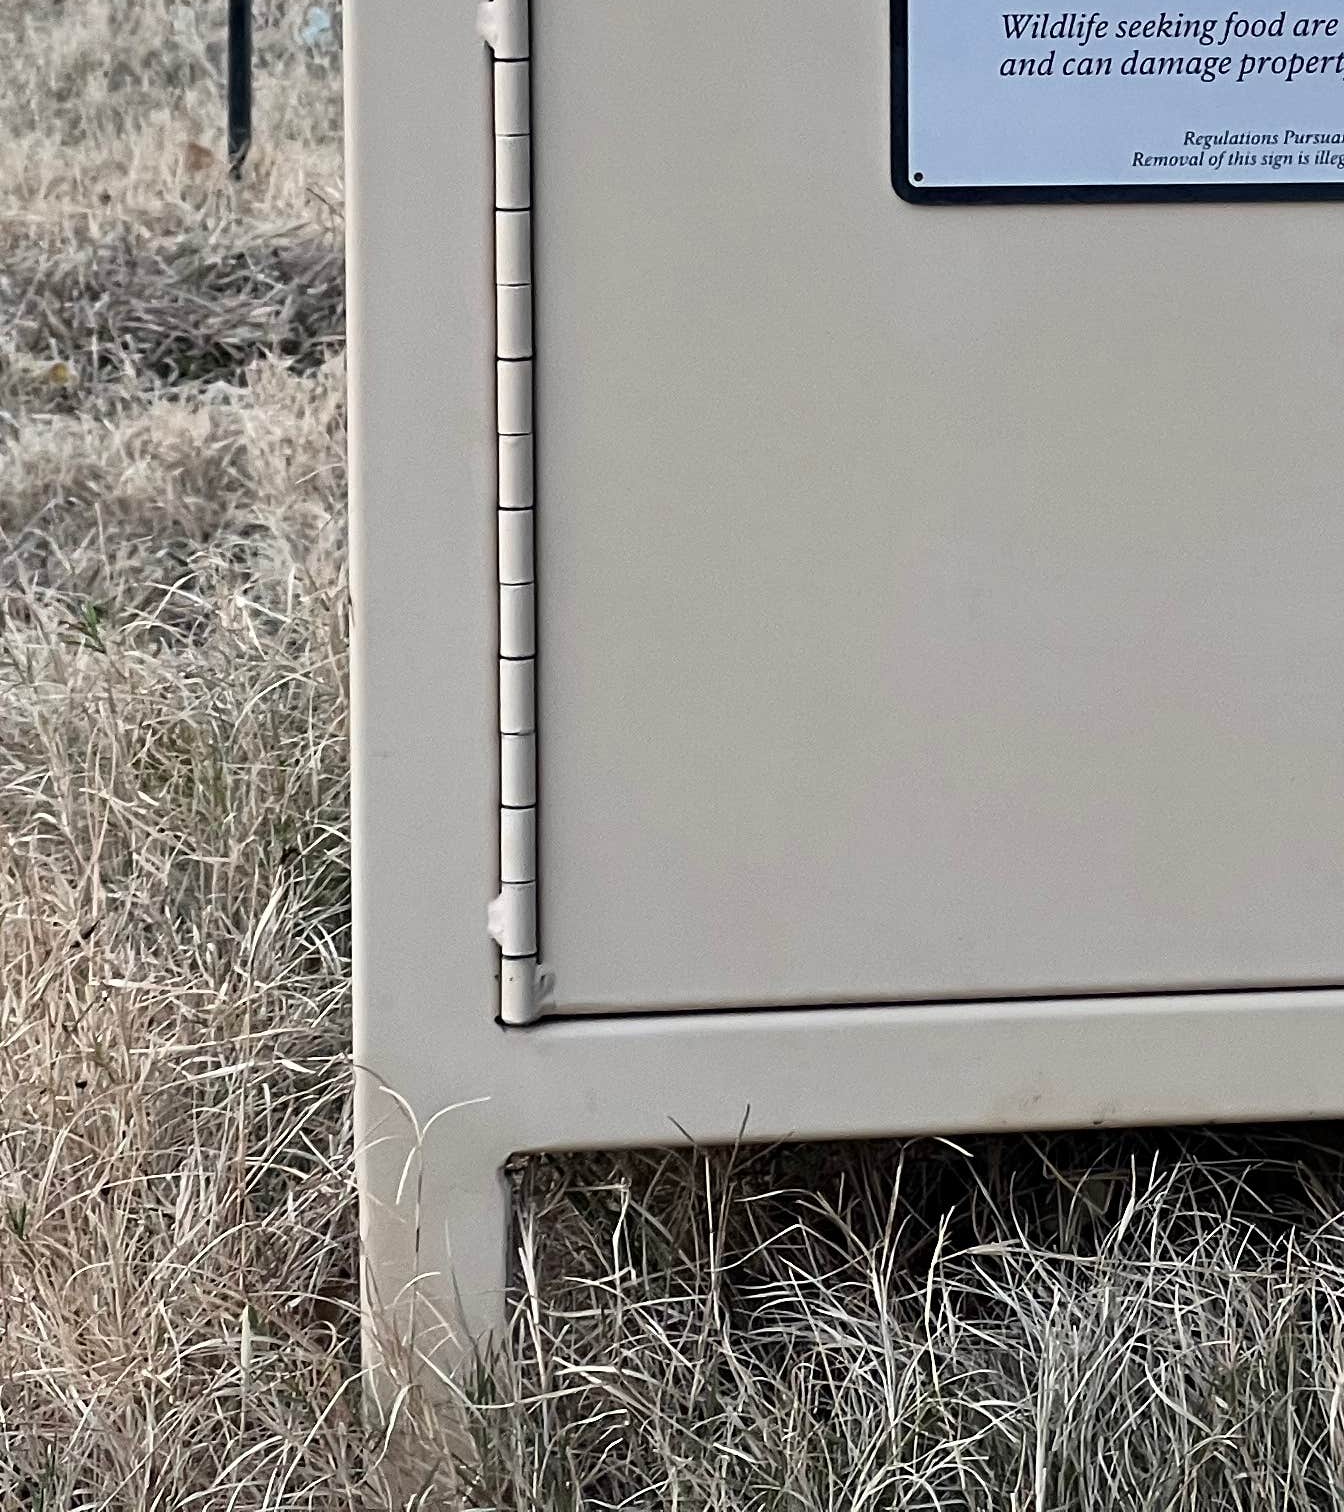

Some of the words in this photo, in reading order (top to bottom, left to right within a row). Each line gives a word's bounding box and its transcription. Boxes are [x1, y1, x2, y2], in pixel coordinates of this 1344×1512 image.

[1002, 13, 1108, 46] Wildlife
[1115, 12, 1218, 46] seeking
[1217, 11, 1286, 45] food
[1293, 18, 1339, 37] are
[1000, 50, 1055, 76] and
[1063, 58, 1112, 75] can
[1121, 50, 1231, 82] damage
[1184, 130, 1278, 149] Regulations
[1132, 151, 1205, 167] Removal
[1208, 151, 1227, 170] of
[1228, 151, 1257, 166] this
[1261, 155, 1292, 169] sign
[1298, 151, 1309, 164] is
